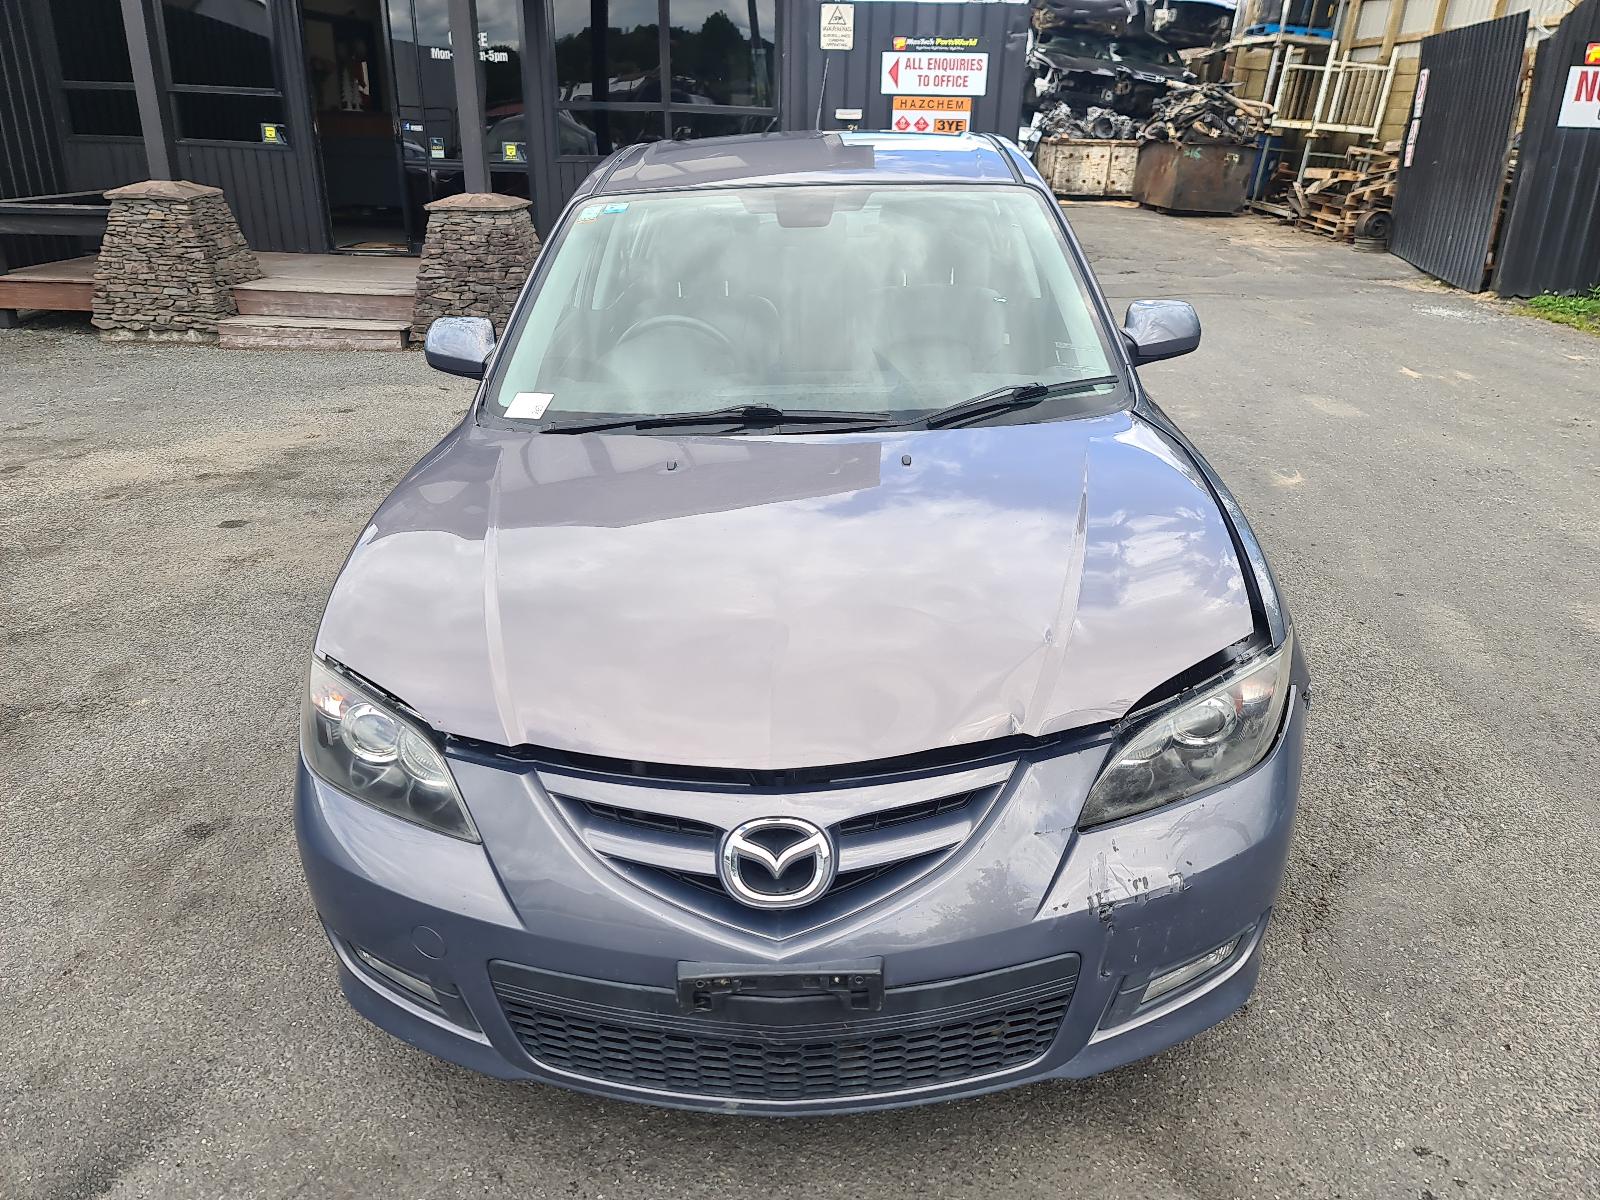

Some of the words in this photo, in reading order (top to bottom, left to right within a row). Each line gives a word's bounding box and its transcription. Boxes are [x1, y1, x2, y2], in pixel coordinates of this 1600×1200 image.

[905, 58, 923, 70] ALL
[927, 58, 983, 72] ENQUIRIES
[918, 75, 930, 87] TO
[933, 75, 969, 88] OFFICE
[1574, 70, 1600, 102] N
[900, 99, 964, 109] HAZCHEM
[937, 120, 964, 131] 3YE
